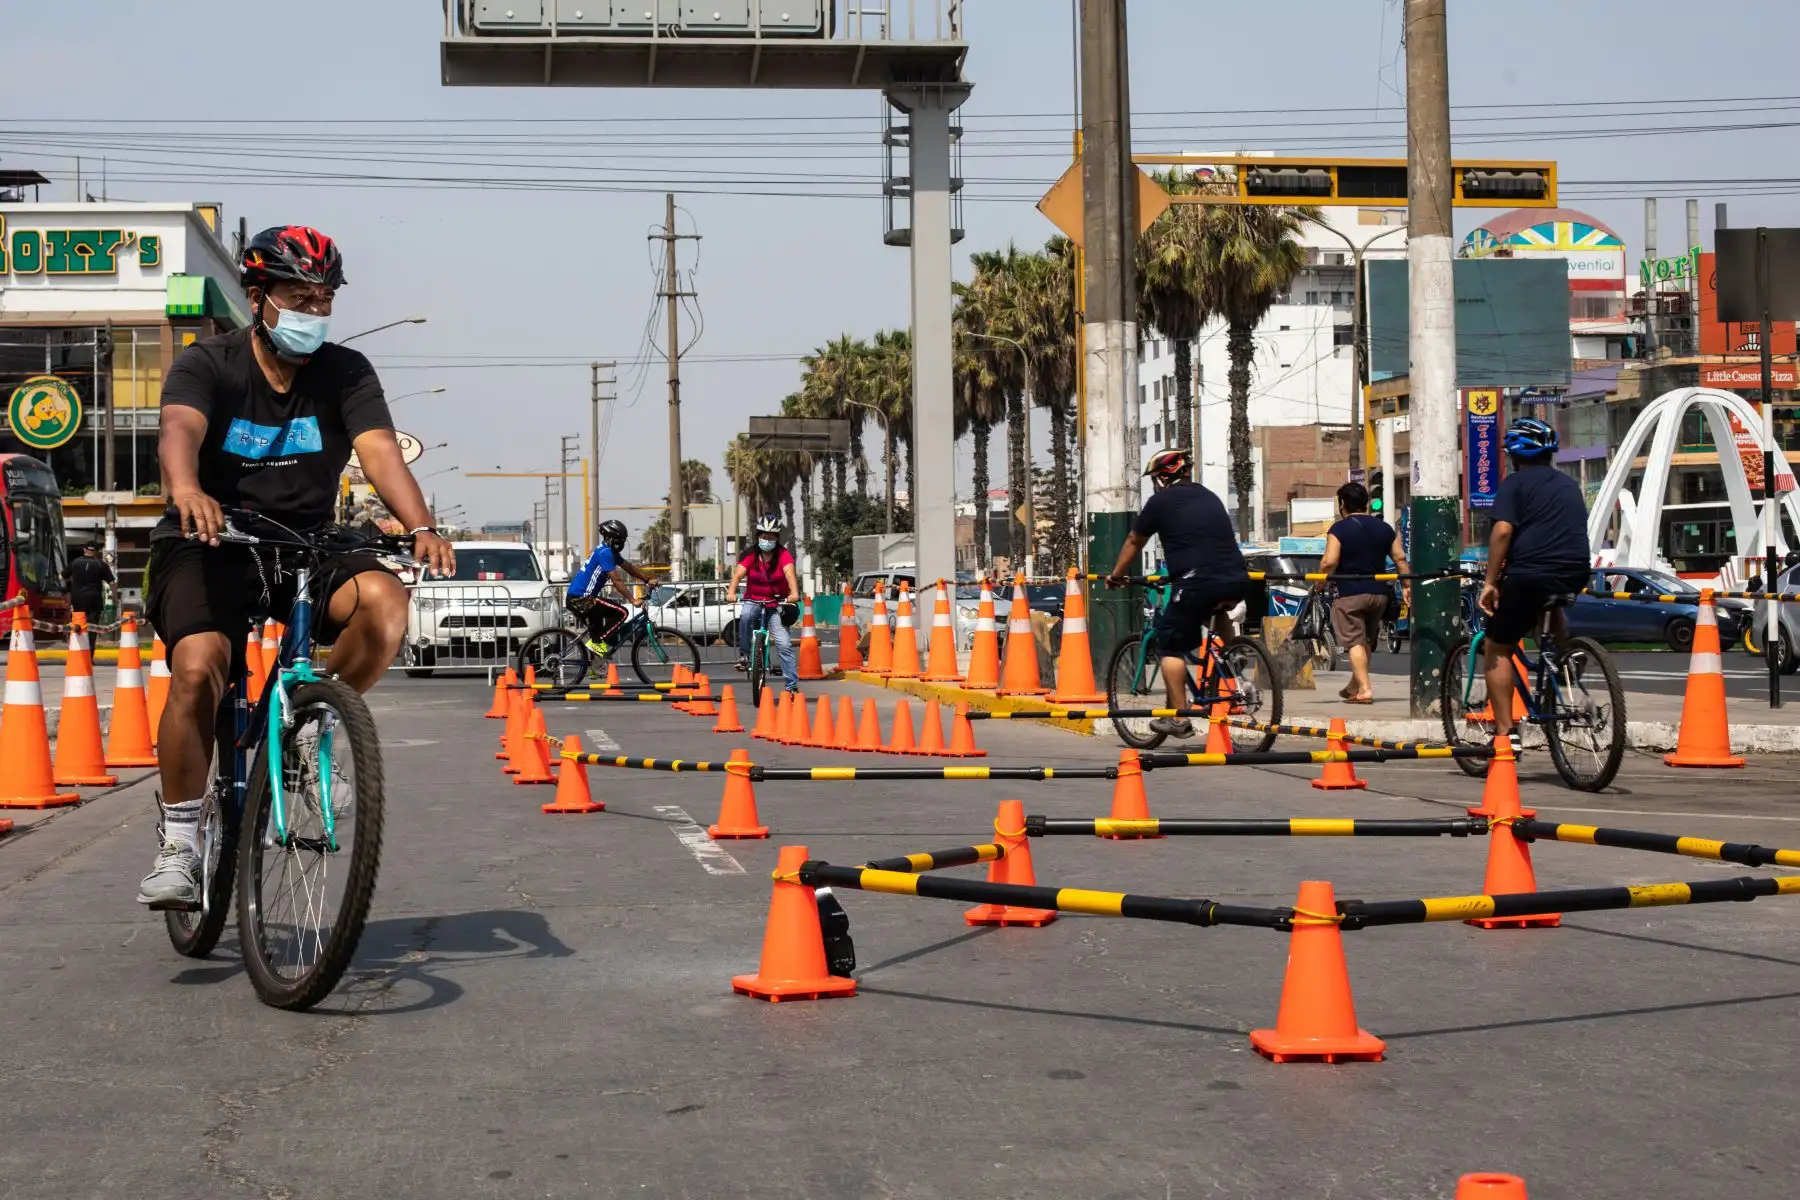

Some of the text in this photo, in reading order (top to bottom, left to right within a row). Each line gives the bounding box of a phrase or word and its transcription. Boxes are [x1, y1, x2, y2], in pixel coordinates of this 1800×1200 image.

[1567, 259, 1615, 272] vential
[1707, 371, 1730, 382] Little
[1732, 371, 1761, 382] Caesar
[240, 432, 269, 446] RIP
[266, 459, 298, 467] AUSTRALIA
